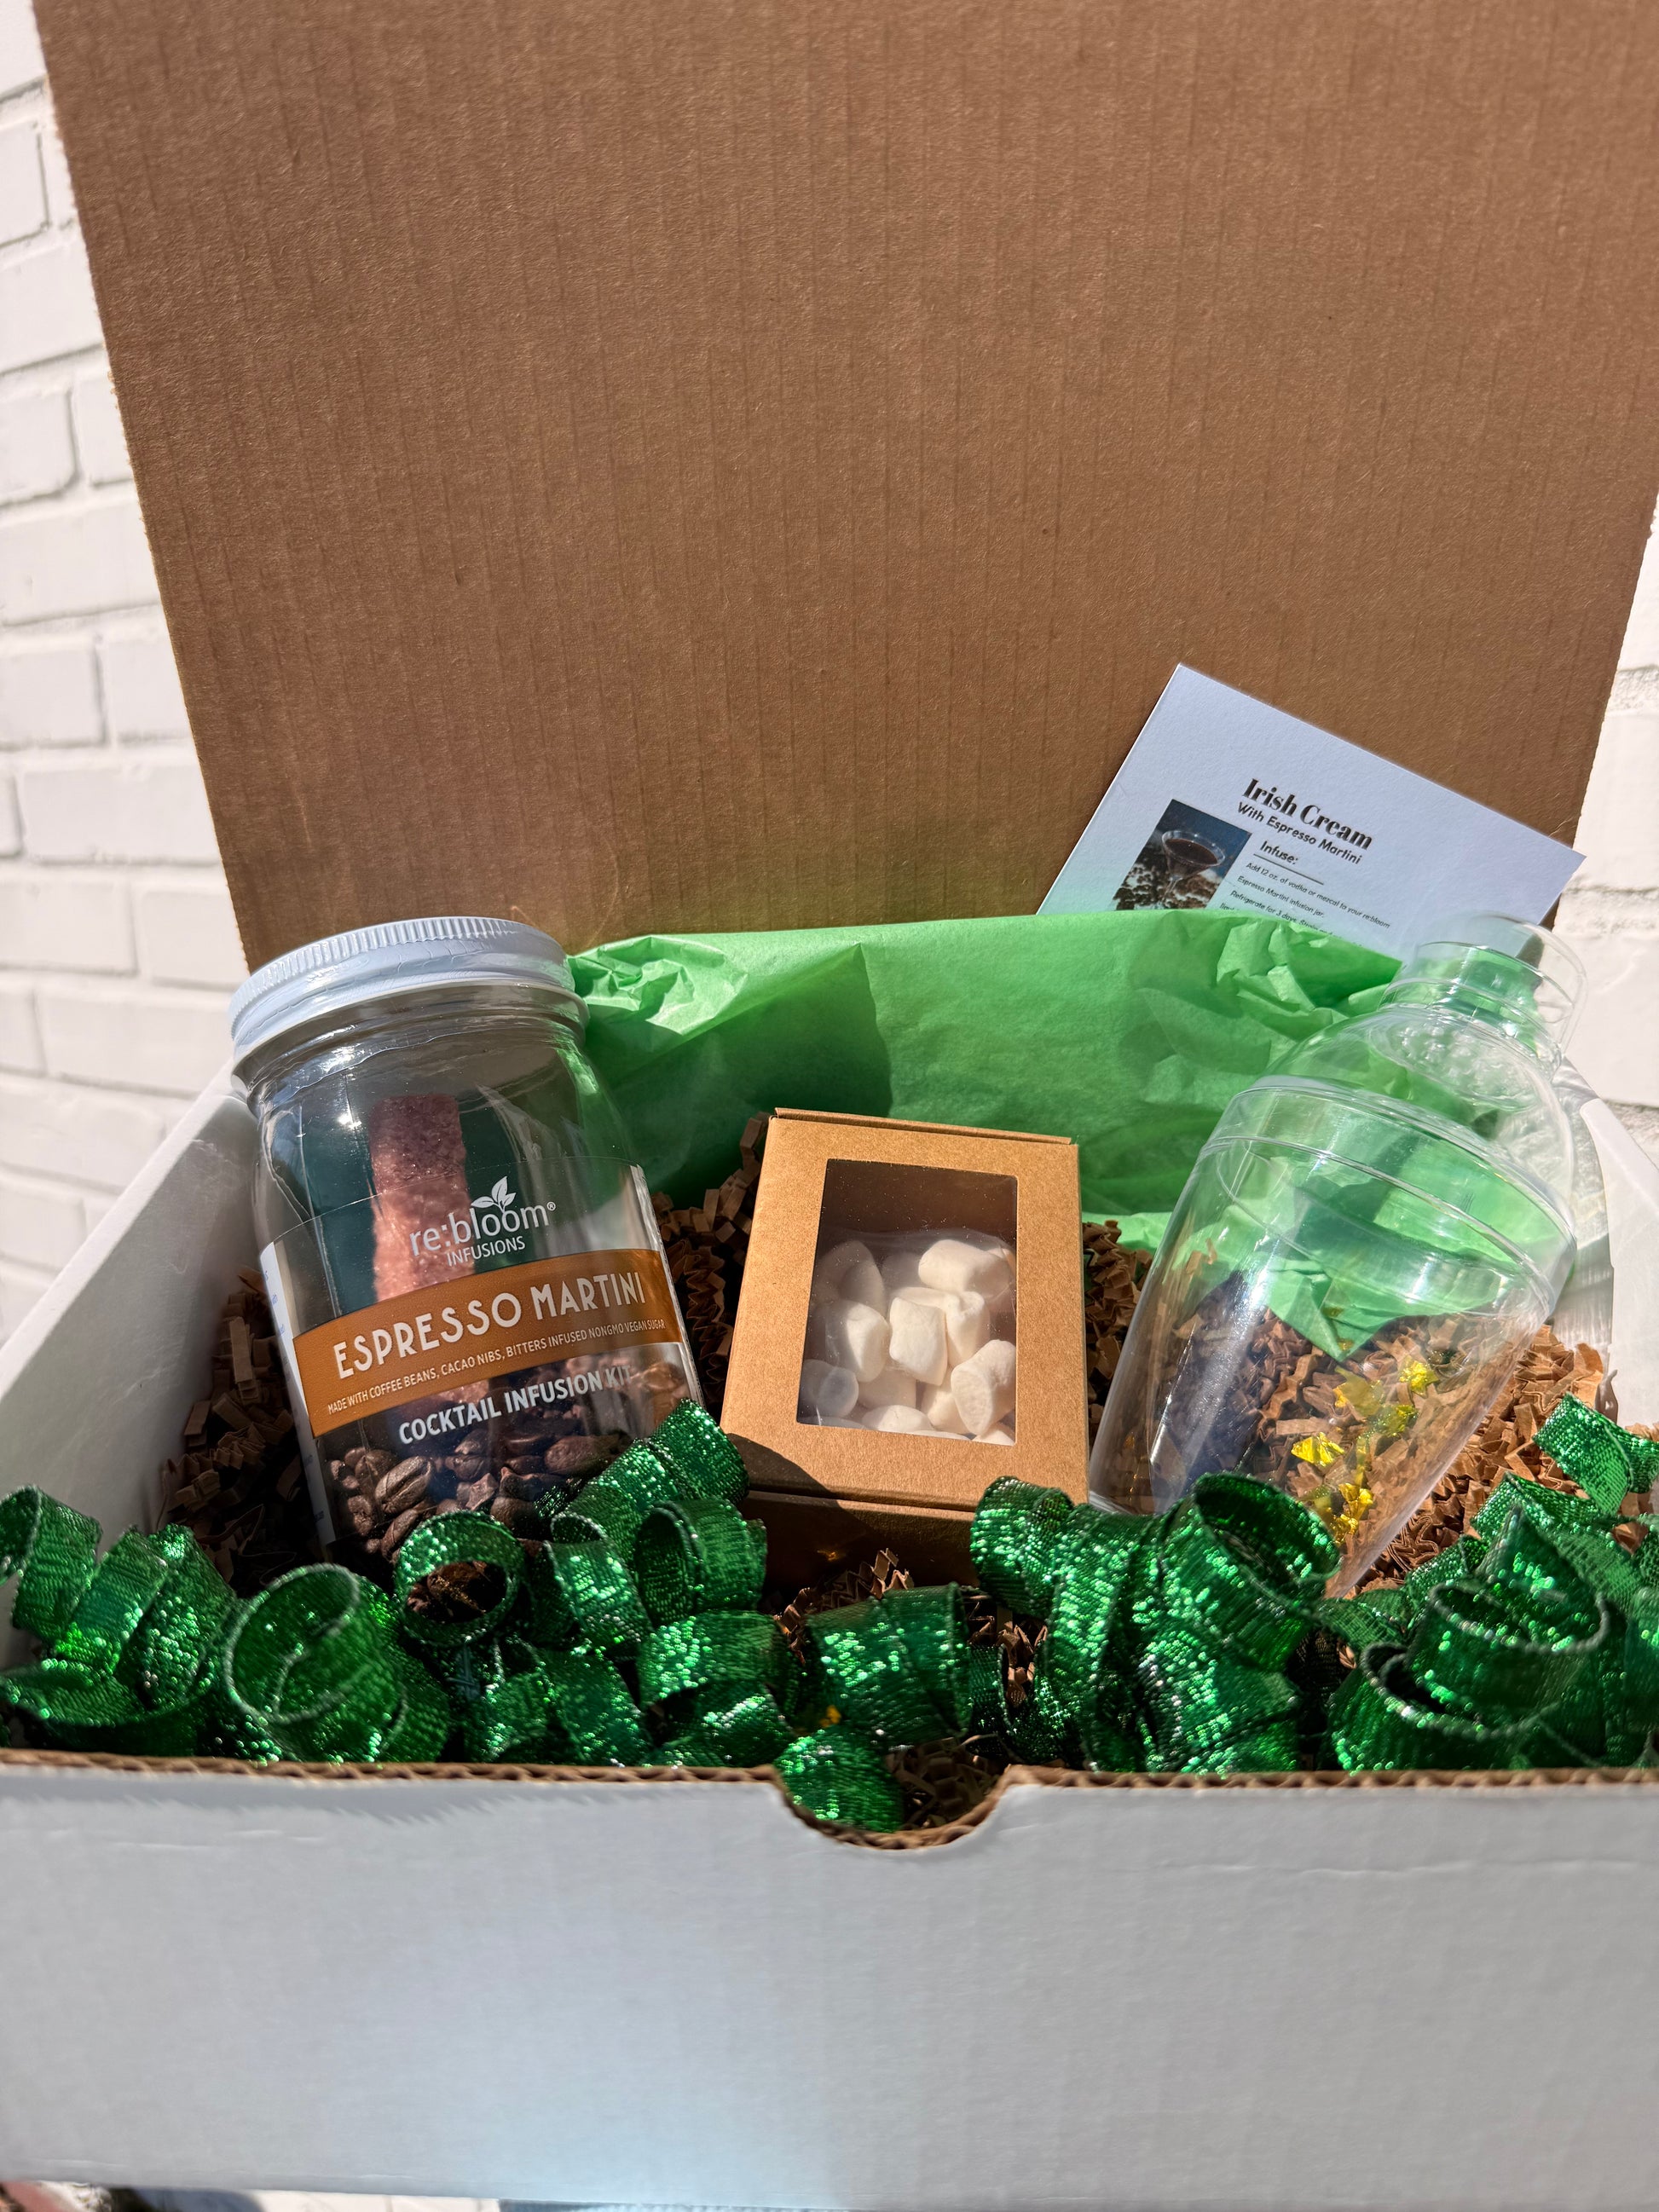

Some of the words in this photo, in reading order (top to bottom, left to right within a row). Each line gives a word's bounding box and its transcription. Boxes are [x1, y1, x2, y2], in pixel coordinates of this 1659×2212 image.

[1237, 801, 1264, 823] With
[1266, 816, 1316, 845] Espresso
[1318, 839, 1363, 864] Martini
[1242, 778, 1298, 817] Irish
[1300, 805, 1373, 850] Cream
[1260, 840, 1299, 865] Infuse:
[1230, 890, 1266, 910] Refrigerate
[1265, 905, 1276, 914] for
[1237, 875, 1264, 892] Espresso
[1266, 888, 1290, 902] Martini
[1290, 898, 1314, 913] infusion
[1246, 863, 1261, 873] Add
[1260, 868, 1269, 876] 12
[1288, 881, 1308, 893] vodka
[1316, 893, 1340, 906] mezcal
[1347, 907, 1362, 916] your
[447, 1235, 526, 1267] INFUSIONS
[333, 1293, 522, 1379] ESPRESSO
[530, 1272, 645, 1320] MARTINI
[328, 1399, 347, 1415] MADE
[348, 1390, 369, 1406] WITH
[369, 1378, 403, 1399] COFFEE
[404, 1367, 440, 1387] BEANS,
[441, 1357, 476, 1376] CACAO
[477, 1349, 506, 1366] NIBS,
[506, 1338, 547, 1358] BITTERS
[548, 1330, 587, 1348] INFUSED
[588, 1323, 624, 1339] NONGMO
[624, 1320, 648, 1332] VEGAN
[647, 1319, 666, 1331] SUGAR
[399, 1397, 502, 1445] COCKTAIL
[504, 1370, 604, 1414] INFUSION
[605, 1365, 633, 1389] KIT
